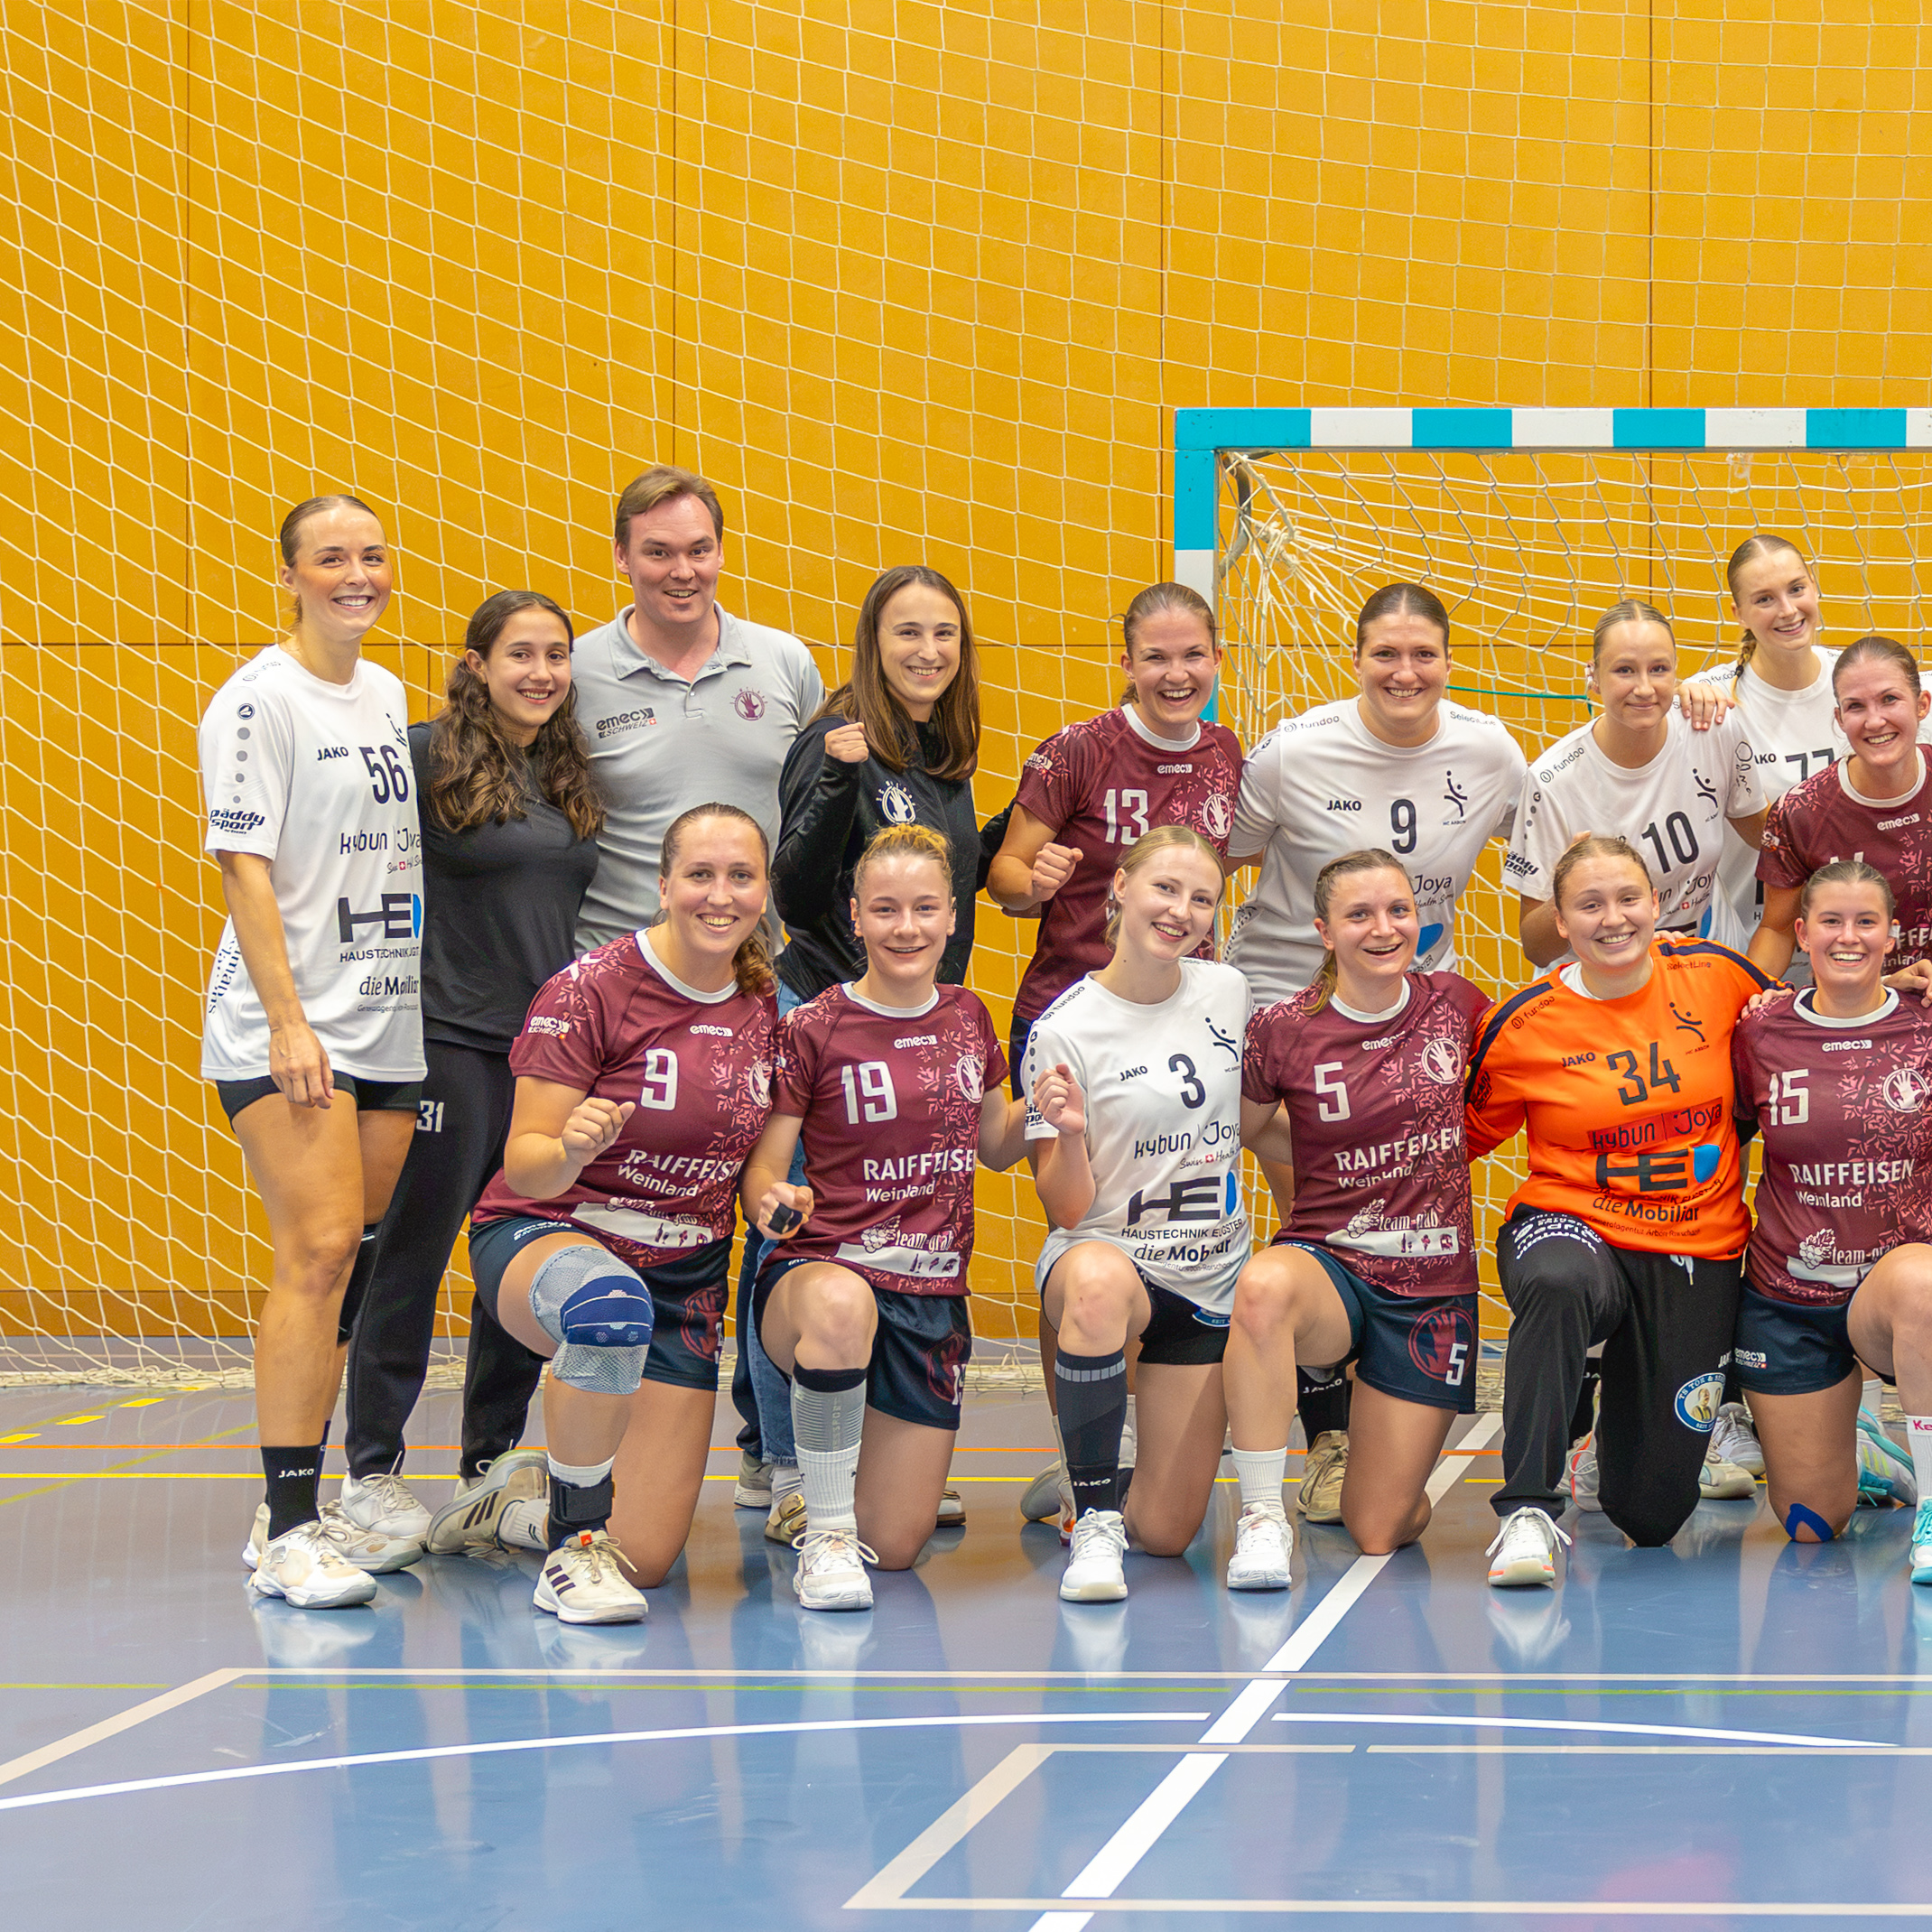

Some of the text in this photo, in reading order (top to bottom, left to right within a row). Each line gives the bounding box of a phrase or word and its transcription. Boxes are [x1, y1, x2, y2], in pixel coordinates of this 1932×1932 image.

[596, 711, 641, 731] emec
[317, 747, 348, 761] JAKO
[1553, 747, 1584, 773] fundoo
[358, 745, 408, 803] 56
[1156, 764, 1185, 774] emec
[209, 808, 265, 826] päddy
[1103, 788, 1149, 845] 13
[1327, 800, 1361, 811] JAKO
[210, 819, 255, 831] sport
[1390, 799, 1417, 854] 9
[1877, 815, 1912, 831] emec
[339, 830, 387, 855] kybun
[1641, 811, 1700, 874] 10
[1414, 874, 1453, 895] Joya
[1685, 870, 1715, 895] Joy
[359, 976, 382, 995] die
[1524, 996, 1556, 1019] fundoo
[690, 1025, 723, 1036] emec
[894, 1036, 929, 1049] emec
[1822, 1040, 1862, 1052] emec
[1561, 1052, 1596, 1068] JAKO
[641, 1048, 678, 1110] 9
[1120, 1065, 1148, 1082] JAKO
[1168, 1054, 1206, 1109] 3
[1606, 1042, 1681, 1106] 34
[841, 1061, 897, 1124] 19
[1314, 1062, 1351, 1122] 5
[1769, 1069, 1809, 1126] 15
[416, 1100, 444, 1132] 31
[1593, 1103, 1722, 1149] kybun Joya
[1134, 1132, 1192, 1159] kybun
[1334, 1126, 1461, 1171] RAIFFEISEN
[863, 1149, 976, 1181] RAIFFEISE
[1179, 1156, 1203, 1169] Swiss
[1788, 1158, 1916, 1186] RAIFFEISEN
[618, 1165, 699, 1197] Weinland
[866, 1178, 936, 1203] Weinland
[1593, 1194, 1623, 1213] die
[1625, 1200, 1699, 1222] Mobiliar
[1796, 1190, 1862, 1208] Weinland
[1121, 1227, 1209, 1240] HAUSTECHNIK
[1134, 1243, 1166, 1261] die
[1445, 1342, 1468, 1386] 5
[278, 1468, 314, 1478] JAKO
